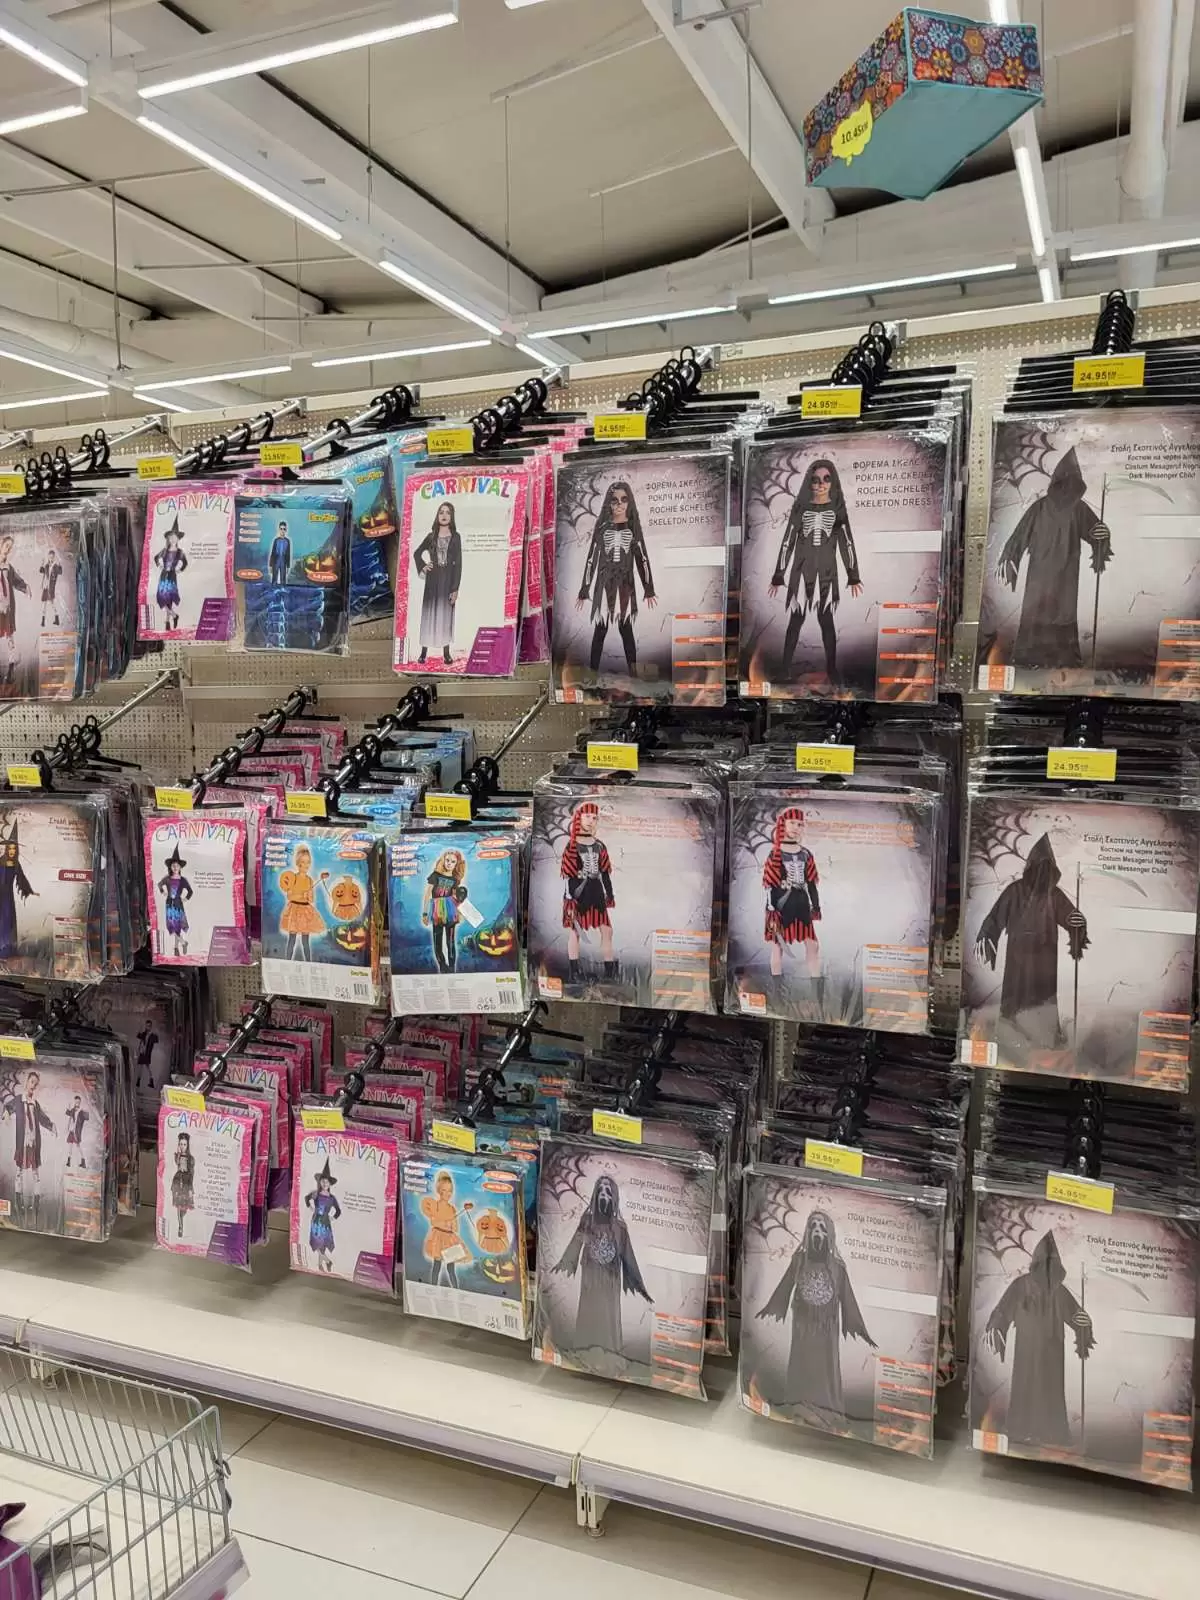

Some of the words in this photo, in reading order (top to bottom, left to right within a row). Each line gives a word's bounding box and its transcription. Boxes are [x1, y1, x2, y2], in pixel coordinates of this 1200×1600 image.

[421, 477, 510, 499] CARNIVAL
[857, 485, 889, 495] ROCHIE
[156, 494, 231, 515] CARNIVAL
[855, 499, 900, 509] SKELETON
[902, 498, 933, 507] DRESS
[648, 517, 687, 527] SKELETON
[155, 822, 234, 844] CARNIVAL
[167, 1111, 241, 1142] CARNIVAL
[304, 1136, 387, 1170] CARNIVAL
